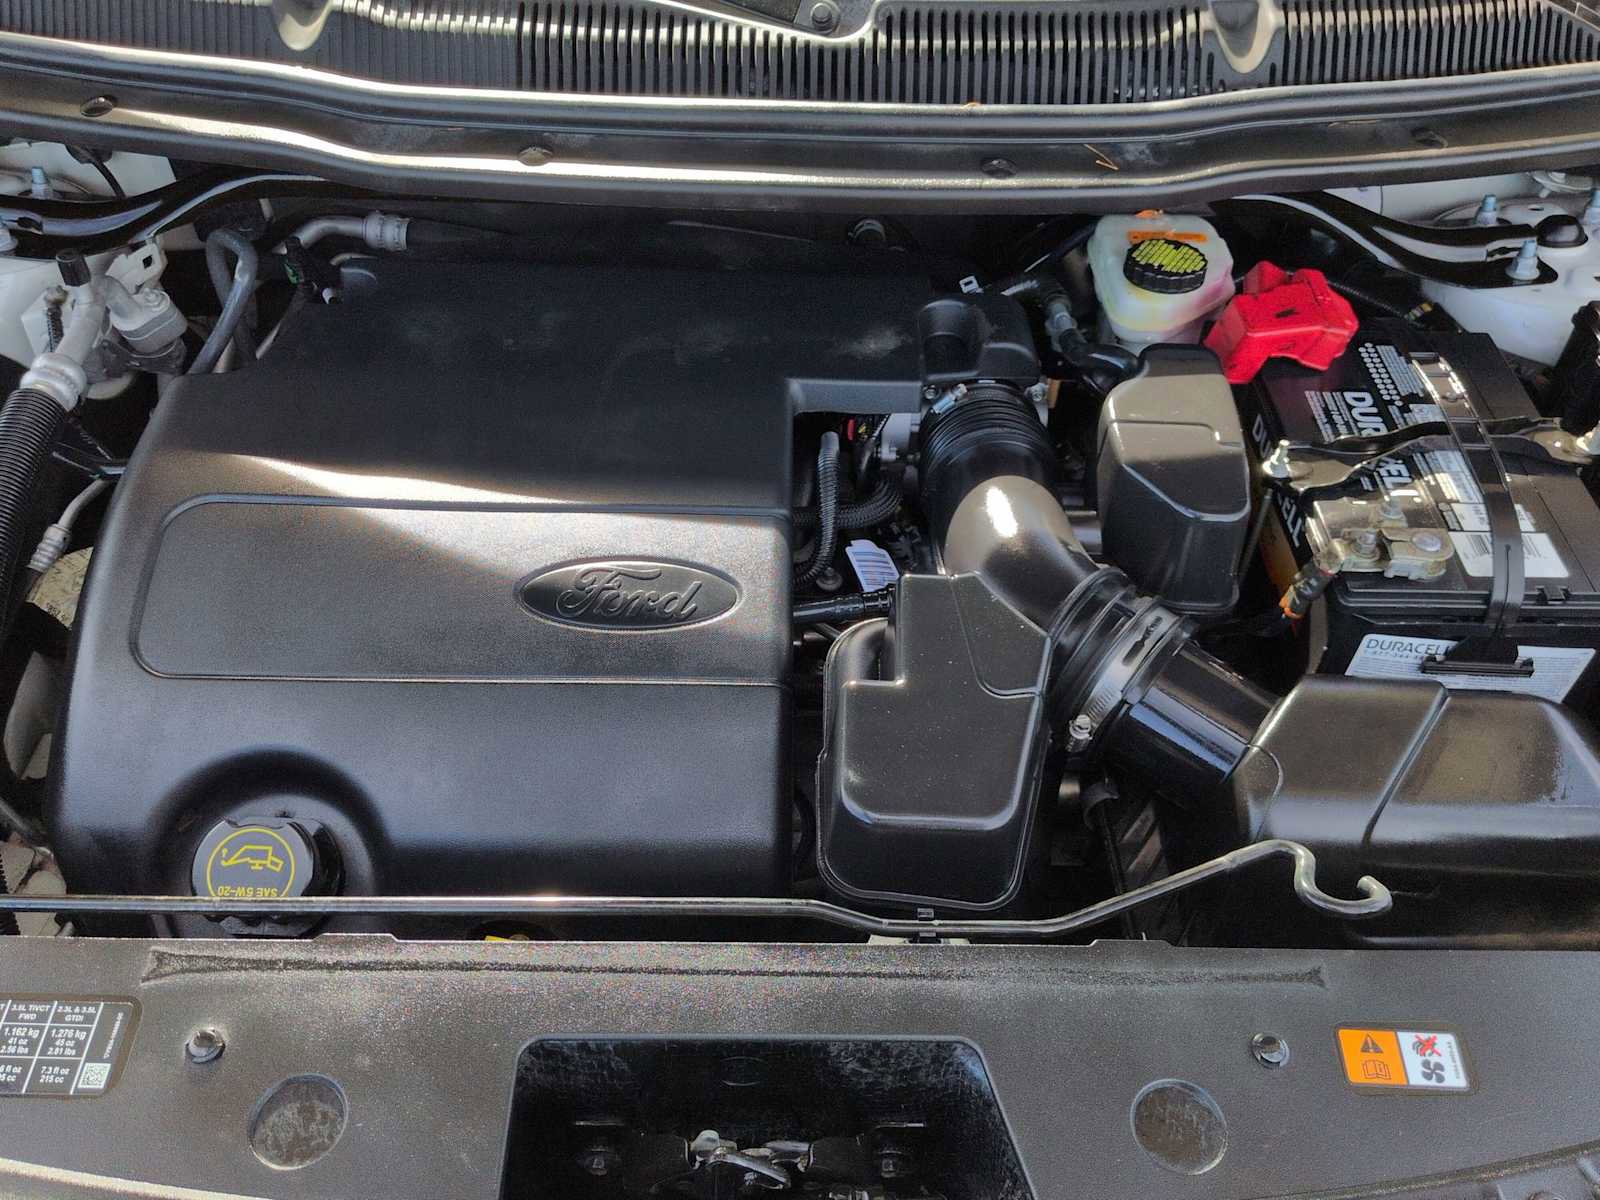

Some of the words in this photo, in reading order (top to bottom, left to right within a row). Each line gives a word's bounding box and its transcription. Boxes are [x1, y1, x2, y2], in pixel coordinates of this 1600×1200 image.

[555, 565, 703, 620] Ford
[4, 1026, 28, 1037] 1.162
[28, 1027, 40, 1039] kg
[51, 1028, 75, 1039] 1.276
[75, 1029, 87, 1041] kg
[8, 1037, 18, 1045] 41
[16, 1045, 29, 1055] lbs
[63, 1047, 76, 1056] lbs
[12, 1065, 22, 1073] oz
[60, 1067, 71, 1075] oz
[6, 1074, 17, 1082] cc
[40, 1074, 54, 1083] 215
